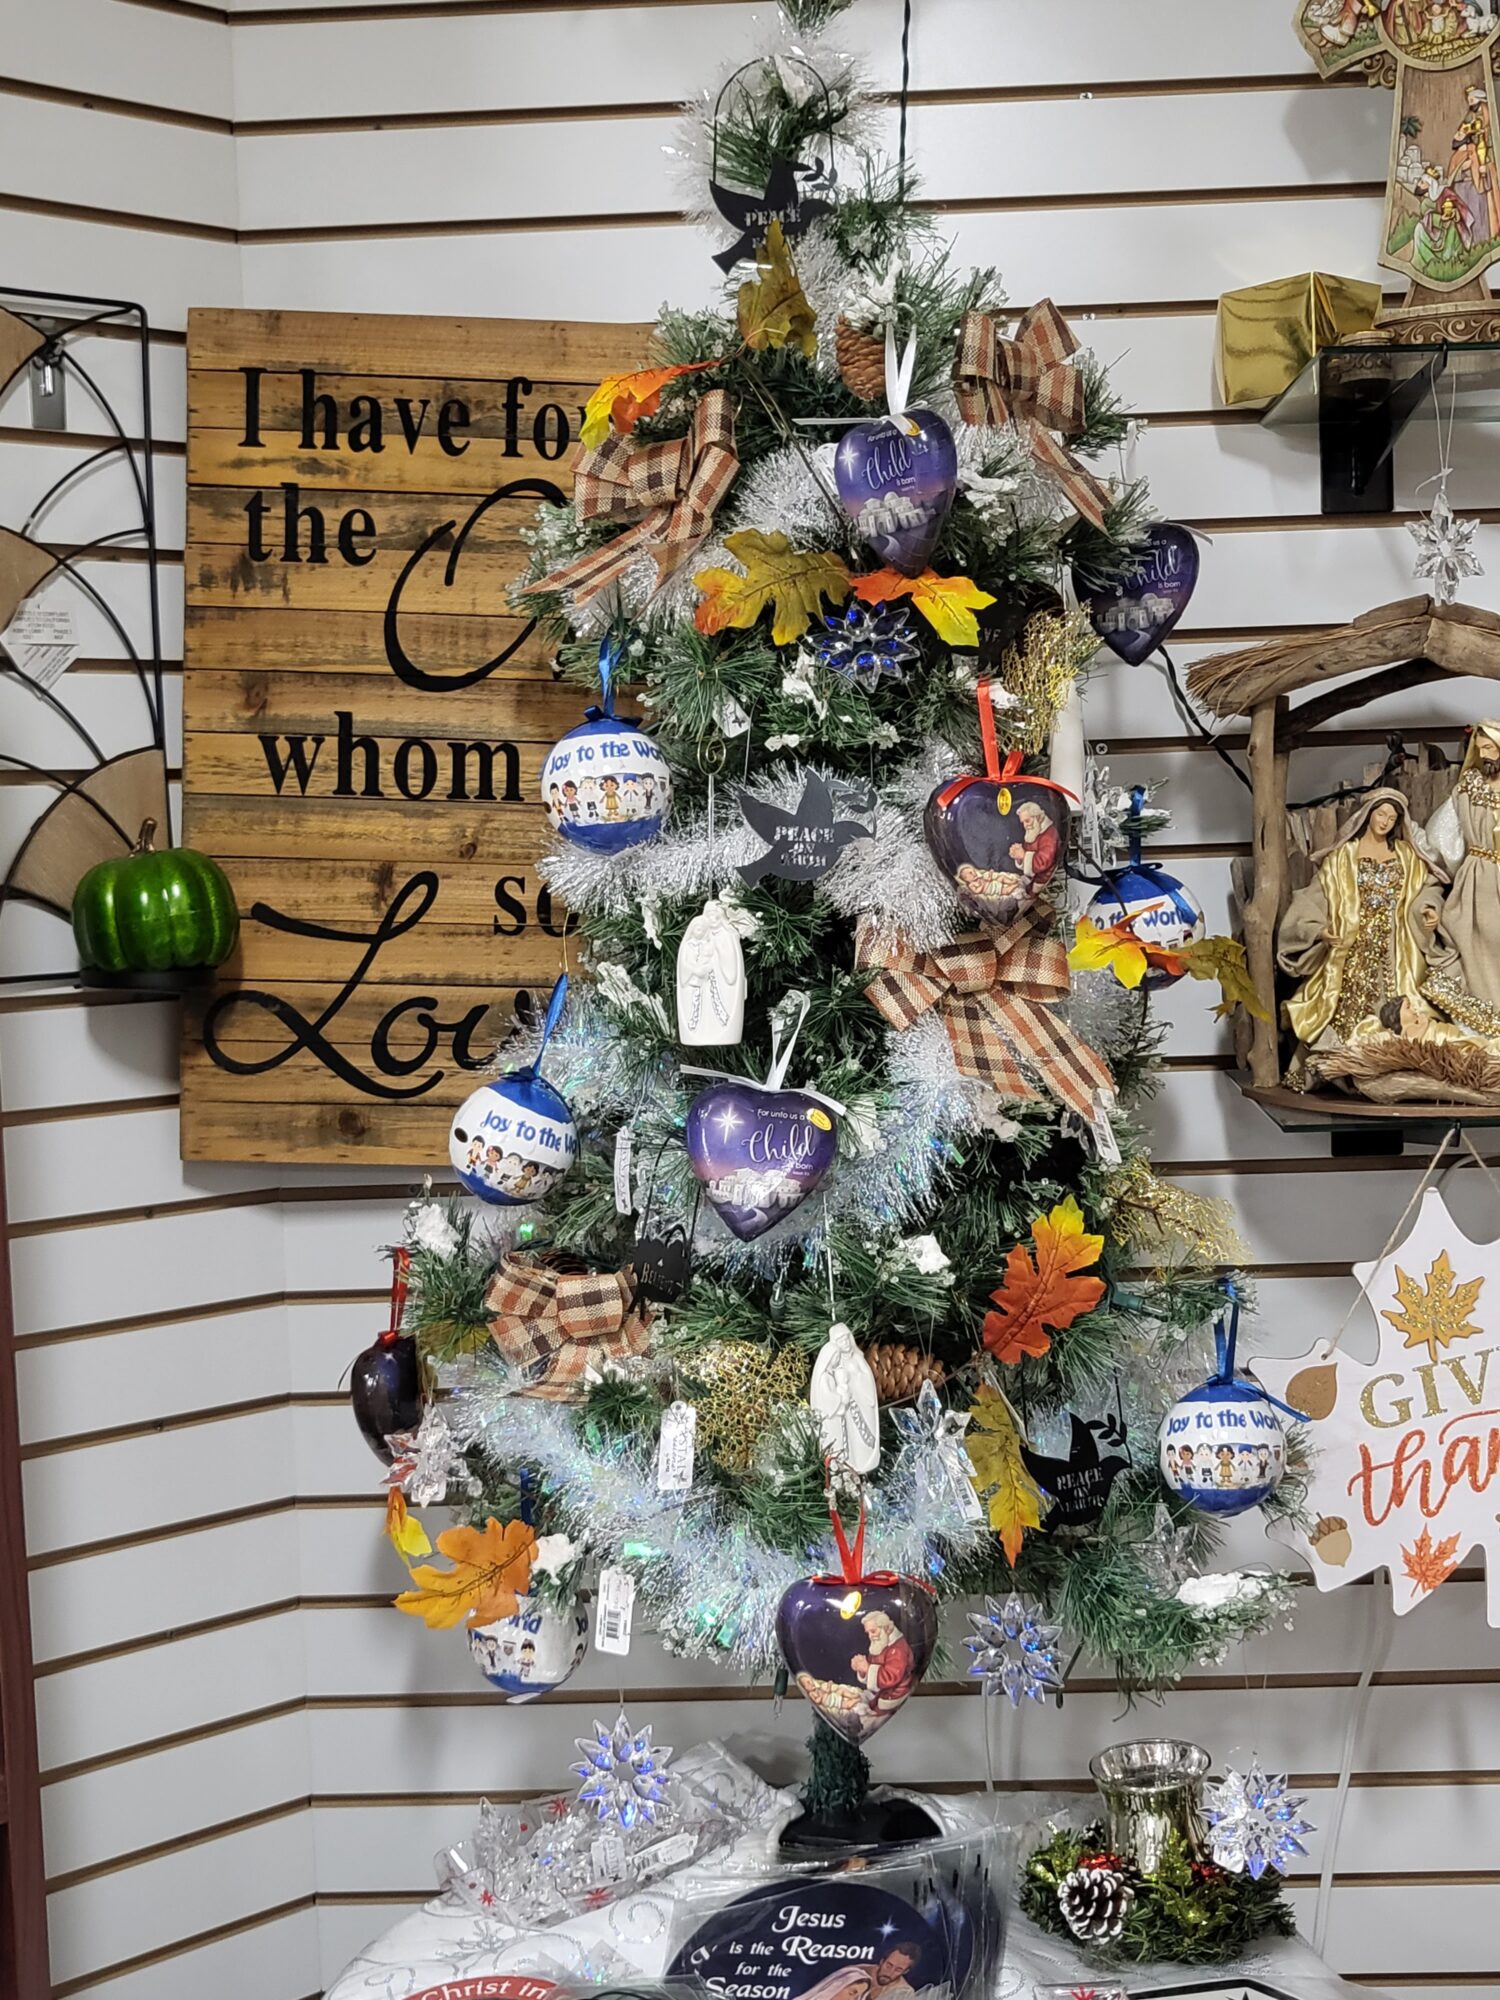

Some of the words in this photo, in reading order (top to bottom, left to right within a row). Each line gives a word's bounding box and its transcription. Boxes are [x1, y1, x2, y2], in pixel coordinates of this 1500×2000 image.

[237, 367, 267, 448] I
[297, 368, 471, 457] have
[500, 376, 588, 461] fo
[861, 438, 912, 490] Child
[244, 482, 377, 566] the
[257, 711, 525, 801] whom
[549, 751, 572, 775] Joy
[576, 745, 595, 762] to
[600, 740, 630, 758] the
[632, 740, 663, 762] Wo
[774, 825, 835, 844] PEACE
[493, 875, 582, 938] so
[757, 1108, 770, 1119] For
[771, 1110, 788, 1119] unto
[789, 1112, 798, 1120] us
[480, 1110, 513, 1132] Joy
[516, 1120, 536, 1141] to
[539, 1127, 562, 1152] the
[565, 1132, 578, 1155] Wo
[741, 1123, 816, 1163] Child
[1360, 1347, 1500, 1428] GIV
[1167, 1416, 1190, 1436] Joy
[1196, 1411, 1213, 1428] to
[1217, 1409, 1247, 1427] the
[771, 1905, 846, 1932] Jesus
[729, 1941, 744, 1955] is
[750, 1941, 774, 1956] the
[781, 1935, 875, 1965] Reason
[735, 1961, 761, 1976] for
[767, 1963, 793, 1977] the
[519, 1981, 547, 1999] in
[705, 1976, 791, 2000] Season
